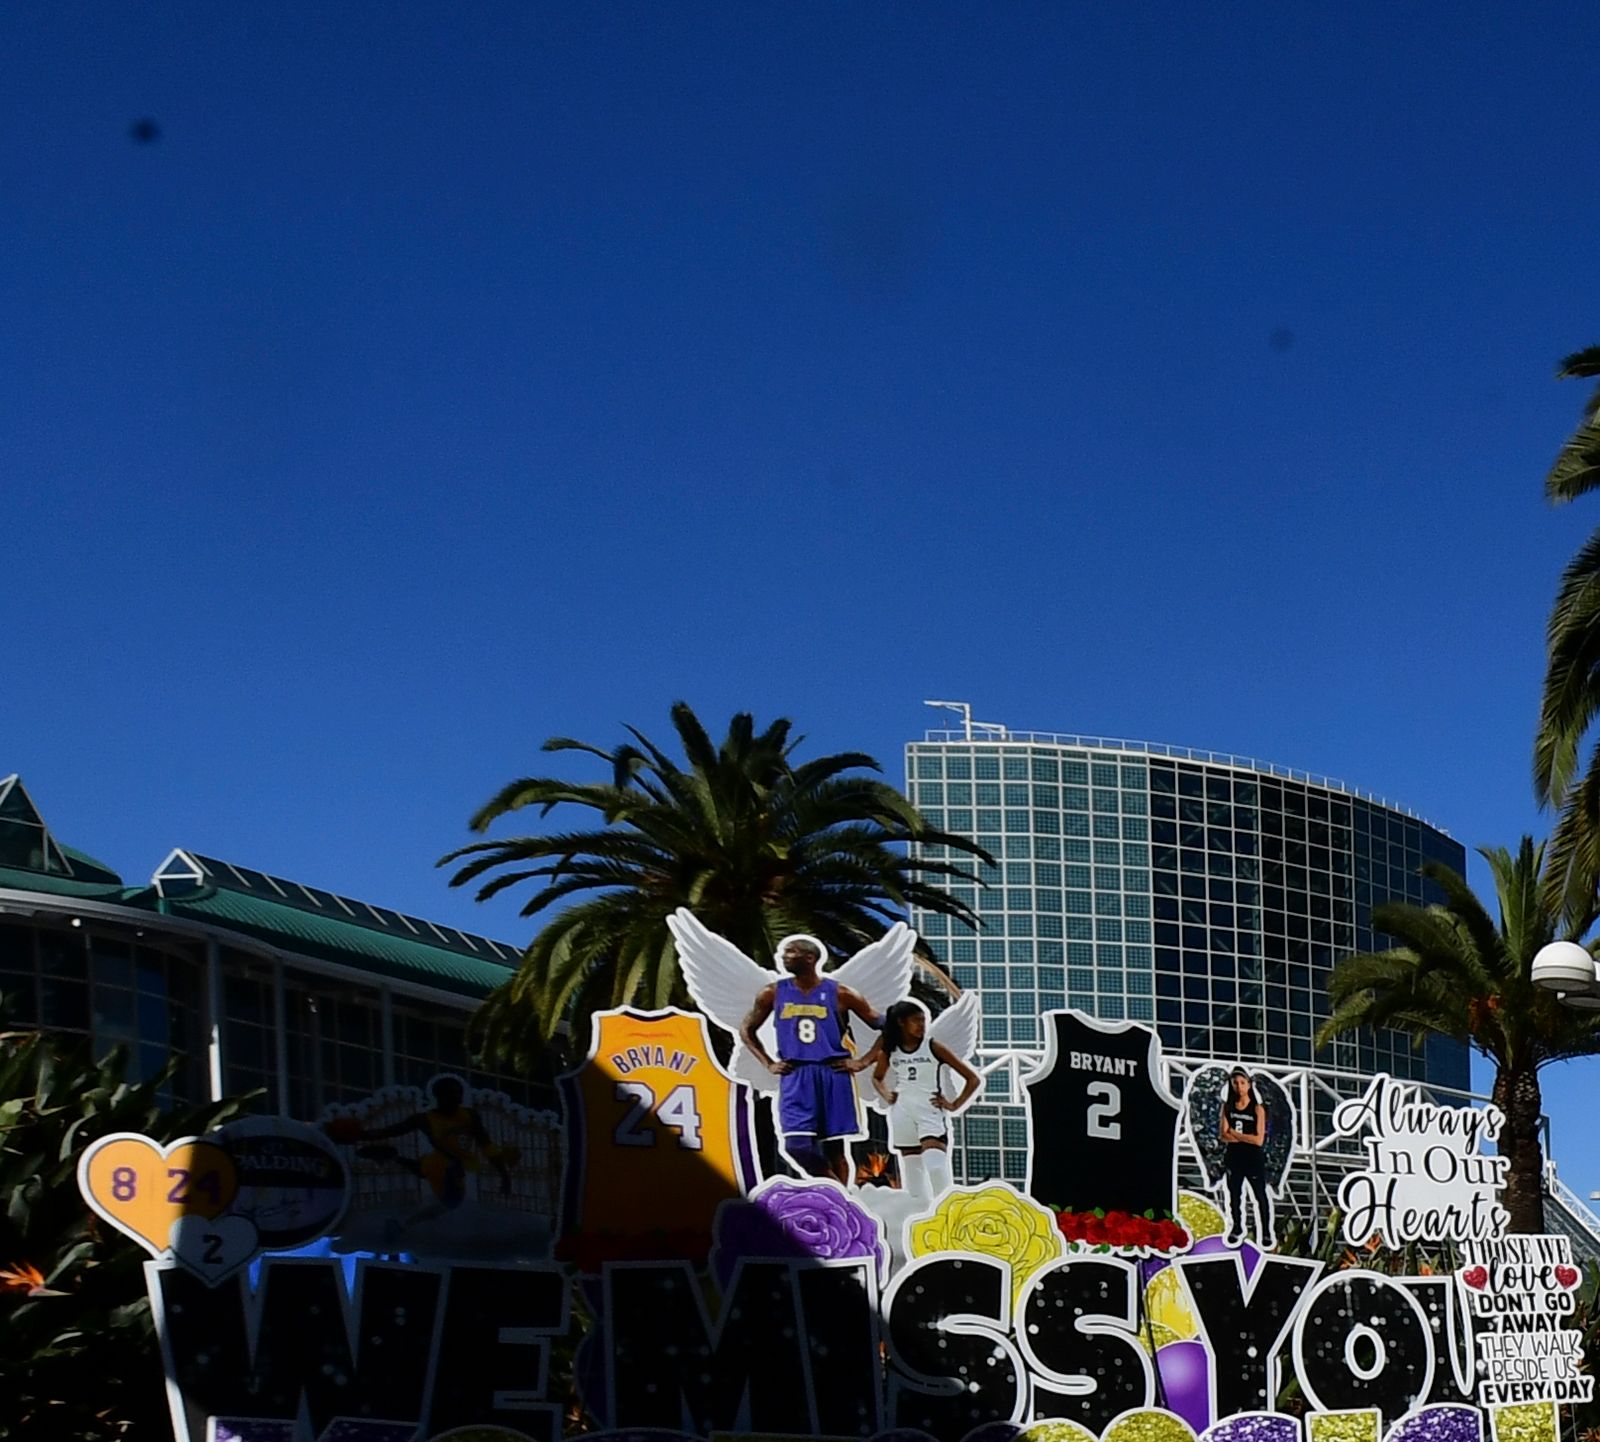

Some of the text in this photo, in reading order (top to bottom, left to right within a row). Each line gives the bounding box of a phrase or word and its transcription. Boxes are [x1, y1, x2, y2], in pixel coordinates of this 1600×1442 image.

[798, 1018, 815, 1043] 8
[611, 1046, 699, 1075] BRYANT
[908, 1067, 917, 1080] 2
[1070, 1051, 1138, 1077] BRYANT
[614, 1080, 703, 1150] 24
[1086, 1081, 1122, 1140] 2
[1337, 1077, 1502, 1155] Always
[1369, 1141, 1508, 1185] In Our
[110, 1167, 221, 1204] 8 24
[1343, 1176, 1508, 1247] Hearts
[202, 1234, 223, 1264] 2
[1538, 1238, 1571, 1265] WE
[1489, 1257, 1558, 1295] love
[1478, 1291, 1572, 1314] DON'T GO
[1501, 1313, 1558, 1335] AWAY
[602, 1254, 1157, 1436] MISS
[1172, 1252, 1480, 1415] YOU
[1480, 1333, 1582, 1359] THEY WALK
[1492, 1356, 1578, 1382] BESIDE US
